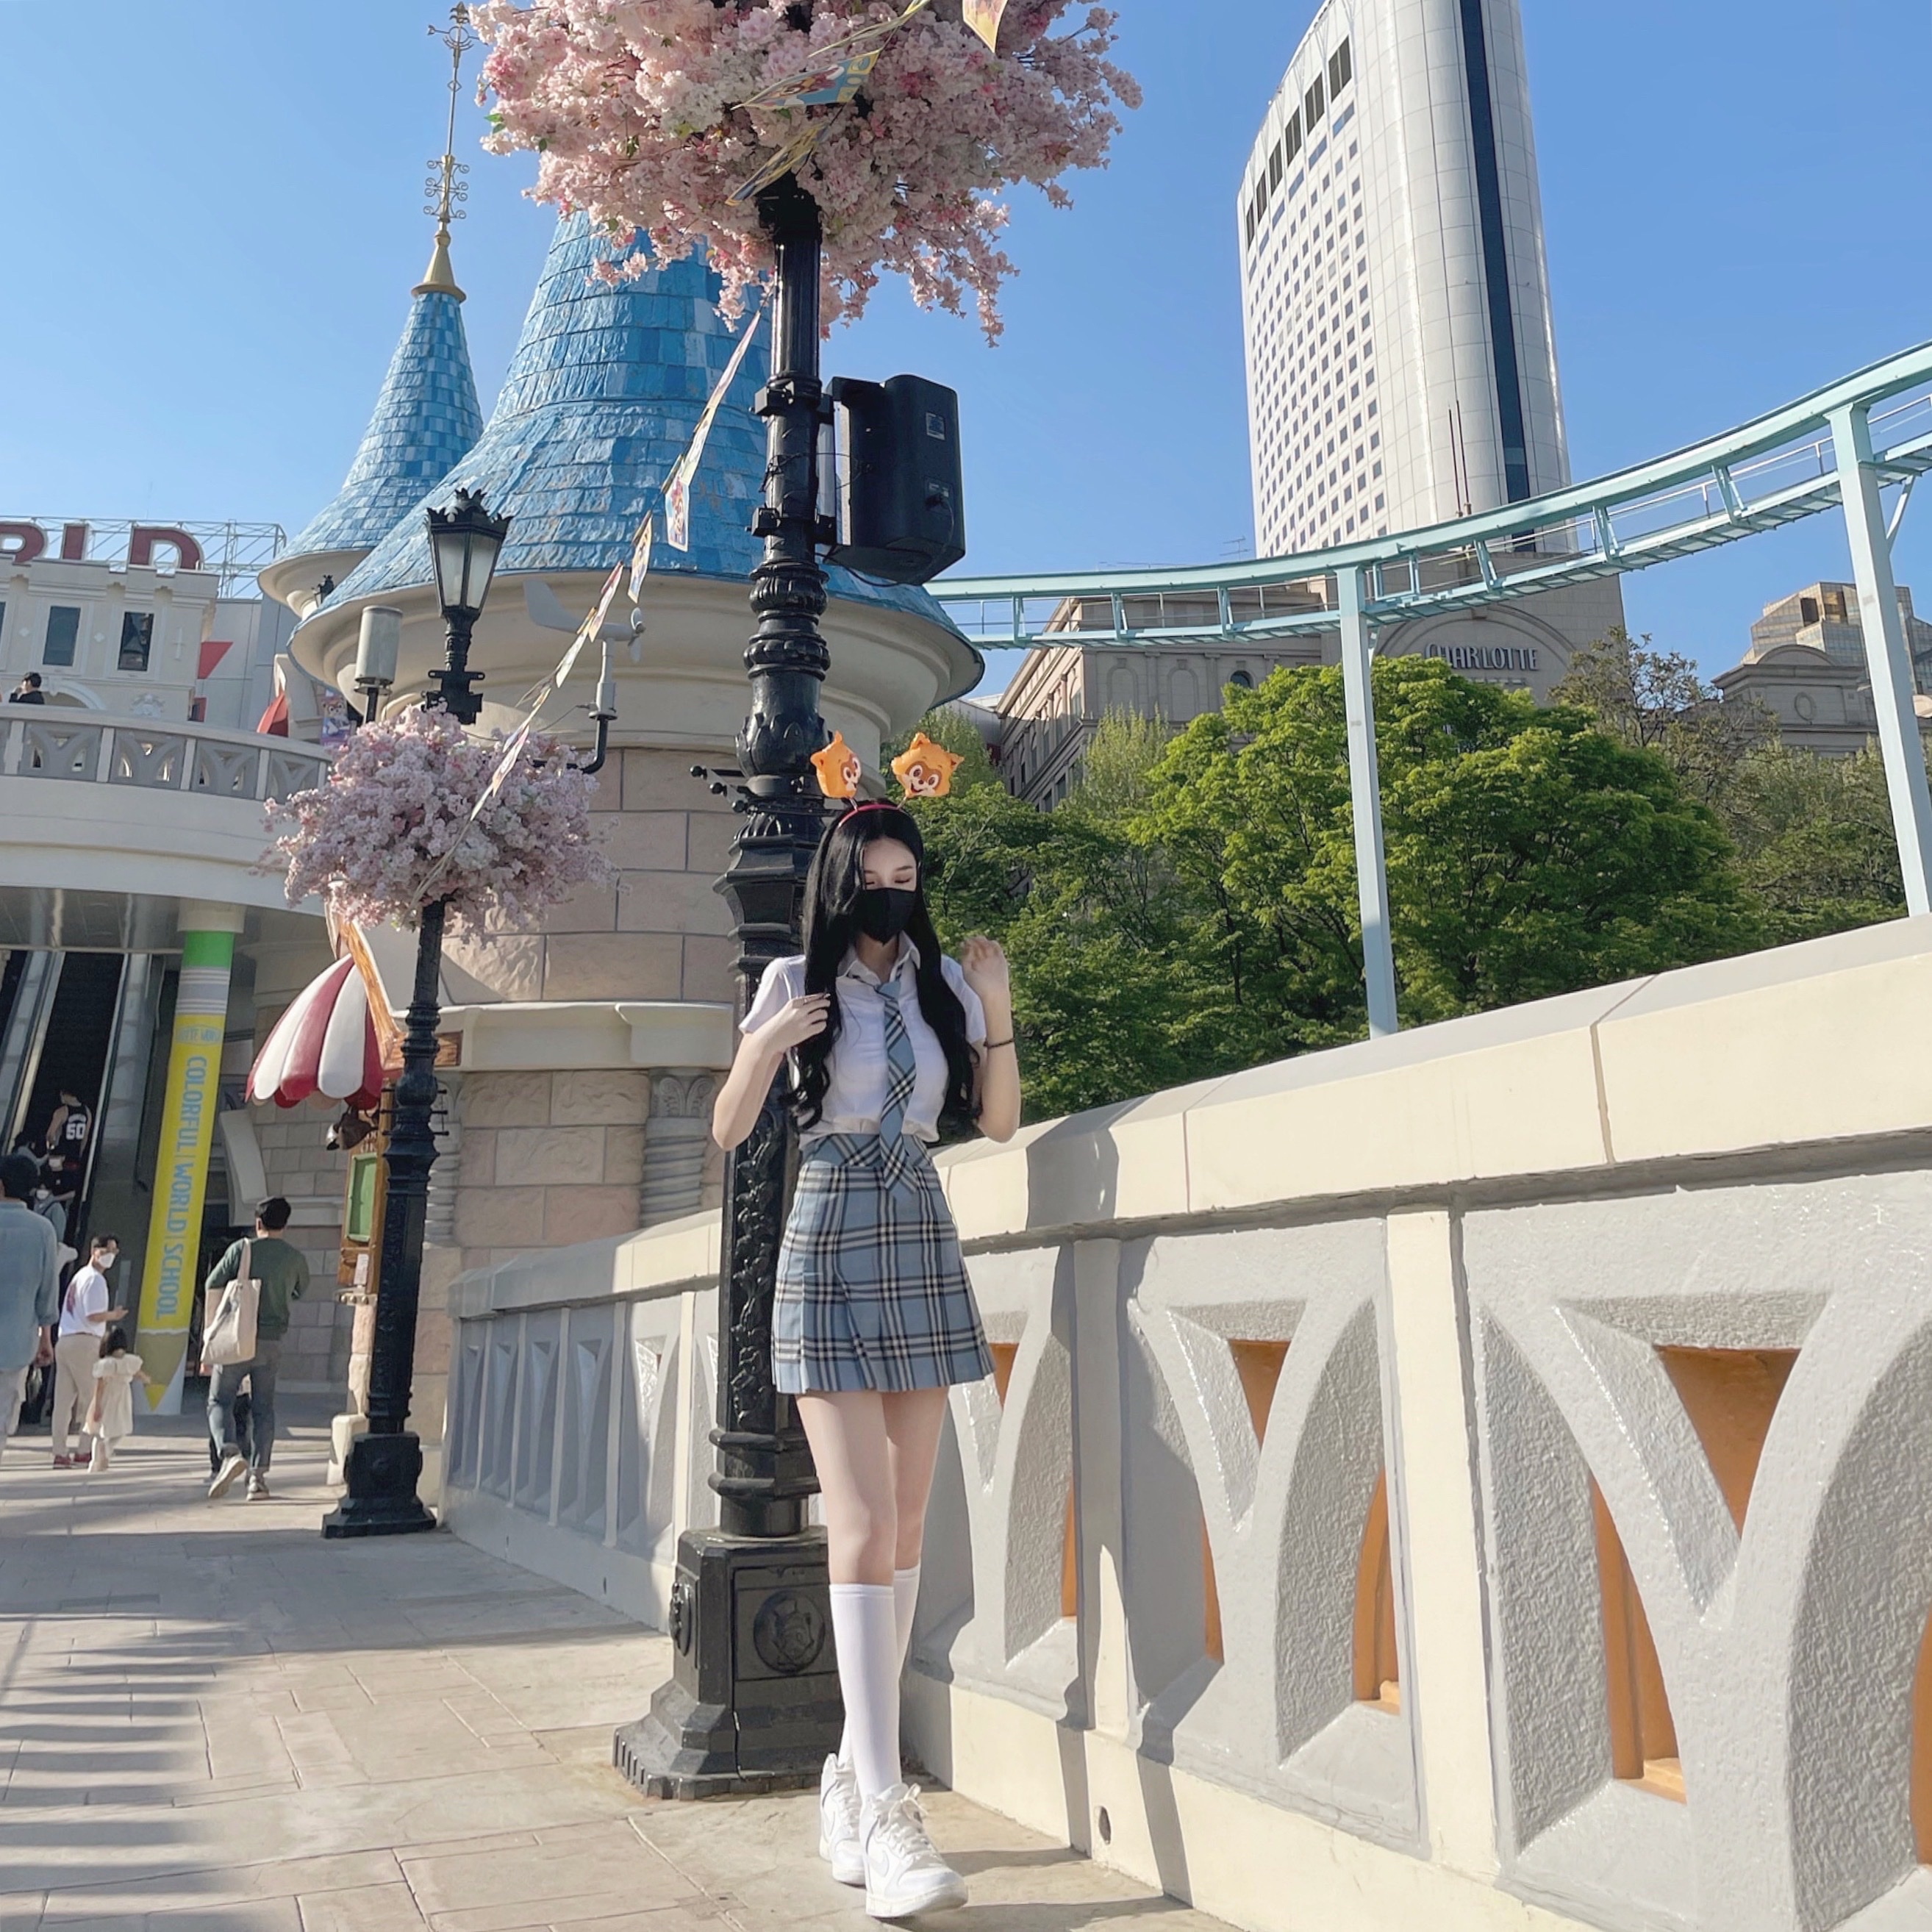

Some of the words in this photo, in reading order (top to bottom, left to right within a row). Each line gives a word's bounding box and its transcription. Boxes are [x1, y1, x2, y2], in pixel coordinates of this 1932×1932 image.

[66, 1123, 86, 1140] 50
[176, 1055, 207, 1153] COLORFUL
[166, 1162, 194, 1233] WORLD
[155, 1243, 184, 1321] SCHOOL
